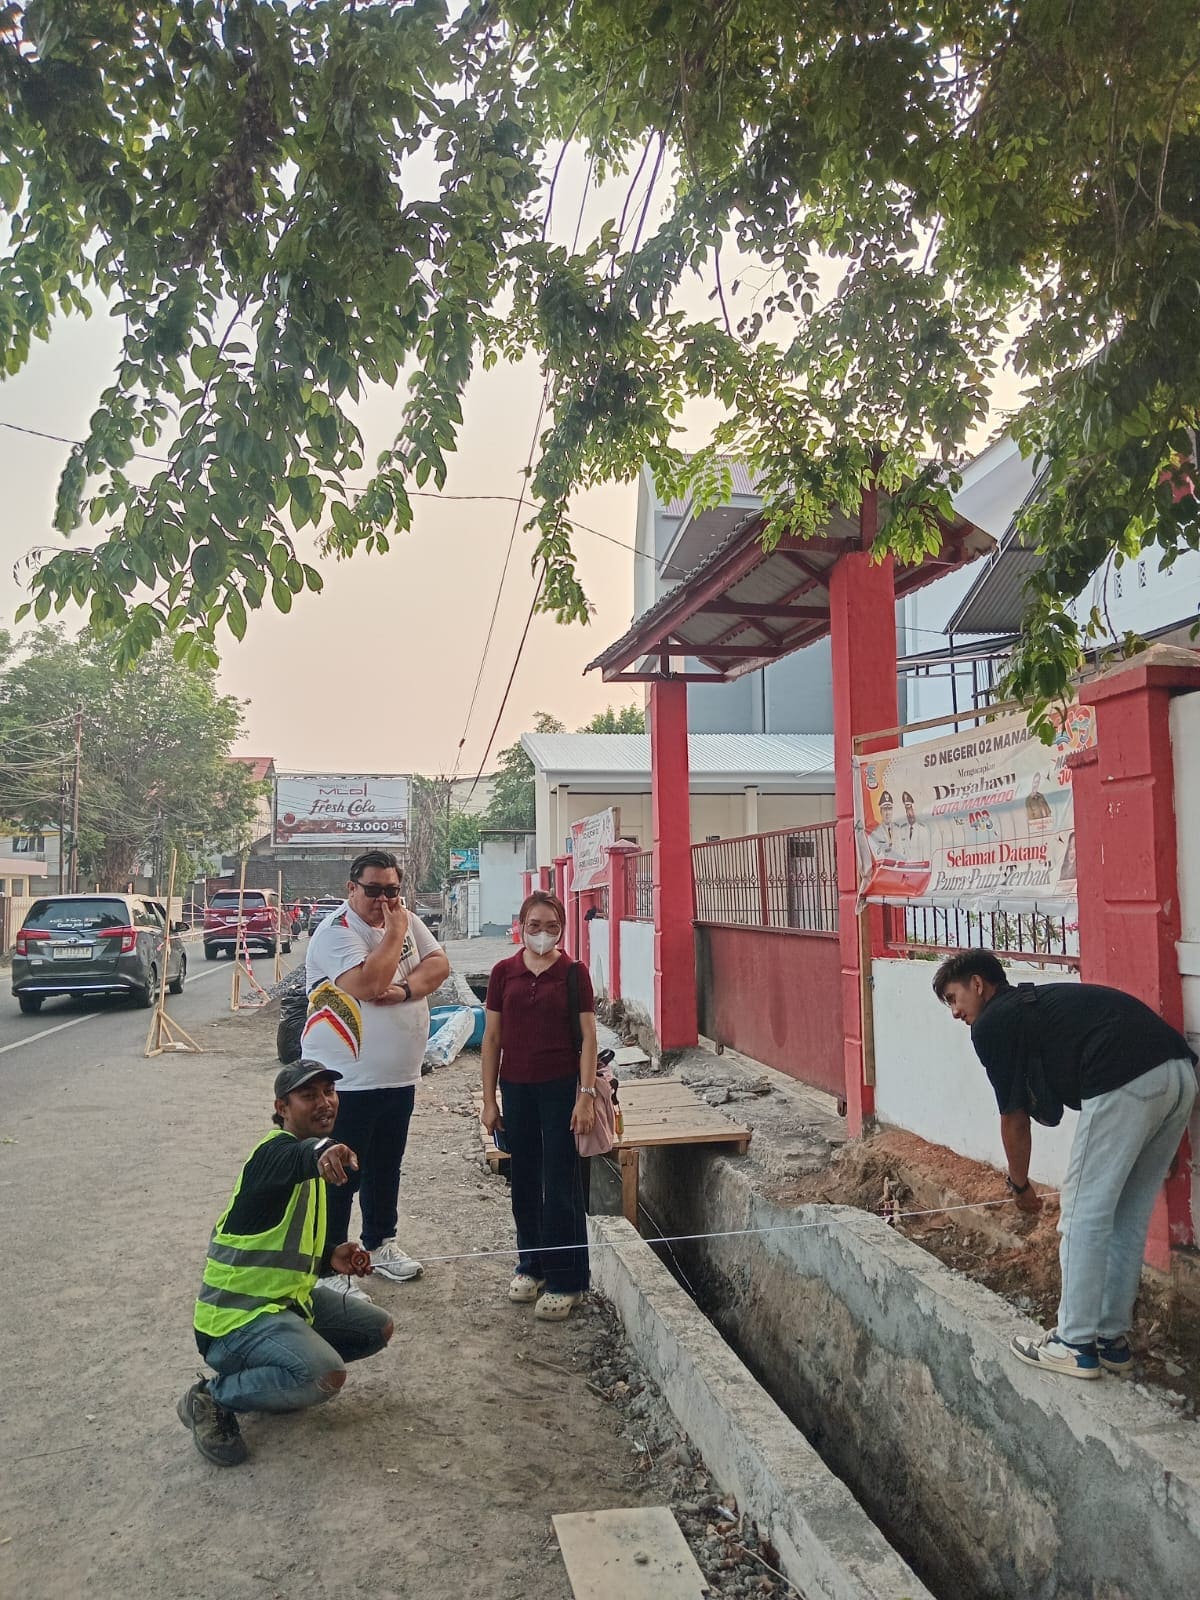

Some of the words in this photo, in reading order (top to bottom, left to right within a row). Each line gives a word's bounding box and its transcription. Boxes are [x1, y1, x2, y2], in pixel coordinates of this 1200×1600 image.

[924, 752, 937, 768] SD
[938, 742, 977, 765] NEGERI
[978, 738, 992, 754] 02
[309, 798, 345, 815] Fresh
[347, 798, 376, 817] Cola
[931, 801, 961, 816] KOTA
[962, 789, 1015, 811] MANADO
[345, 821, 389, 831] 33.000
[946, 849, 996, 868] Selamat
[998, 842, 1048, 866] Datang
